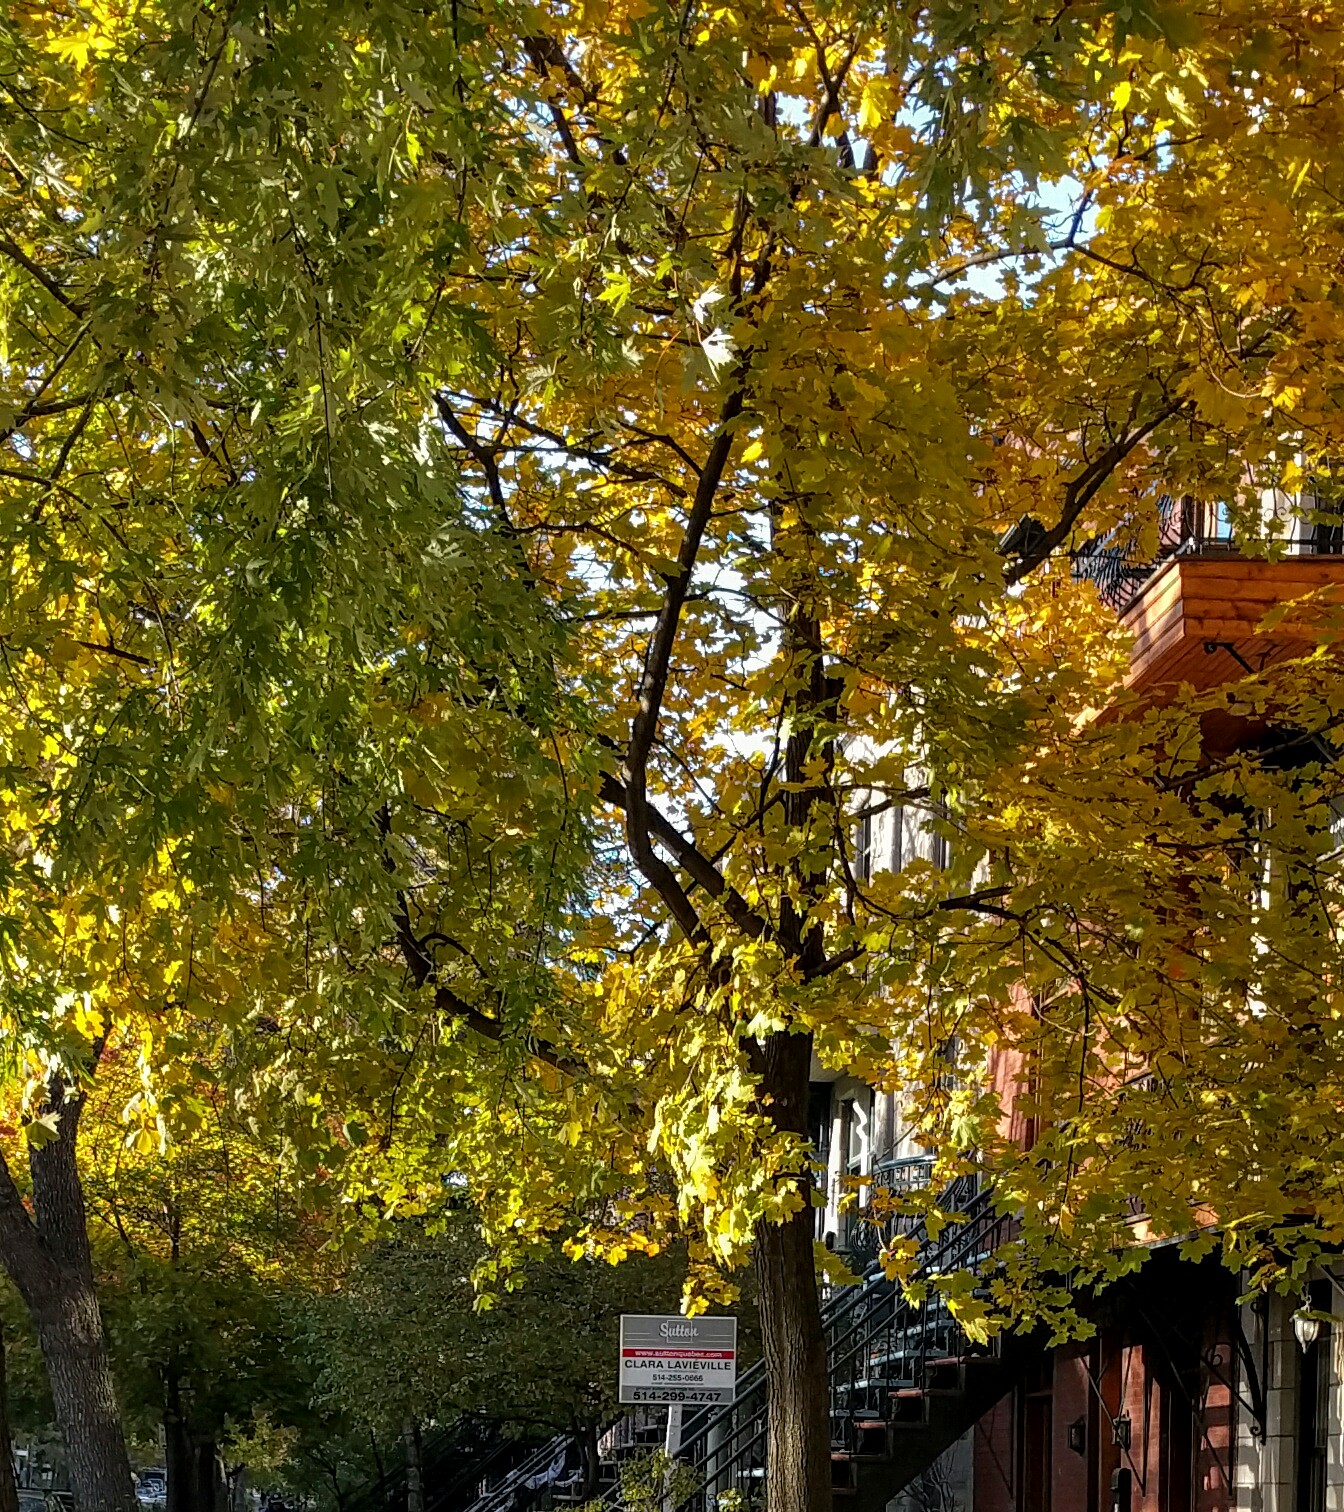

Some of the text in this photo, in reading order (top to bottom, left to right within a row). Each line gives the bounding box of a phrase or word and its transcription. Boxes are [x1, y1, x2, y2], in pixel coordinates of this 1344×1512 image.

[659, 1322, 699, 1337] Sutton
[624, 1359, 732, 1371] CLARA LAVIÉVILLE
[633, 1391, 722, 1402] 514-299-4747
